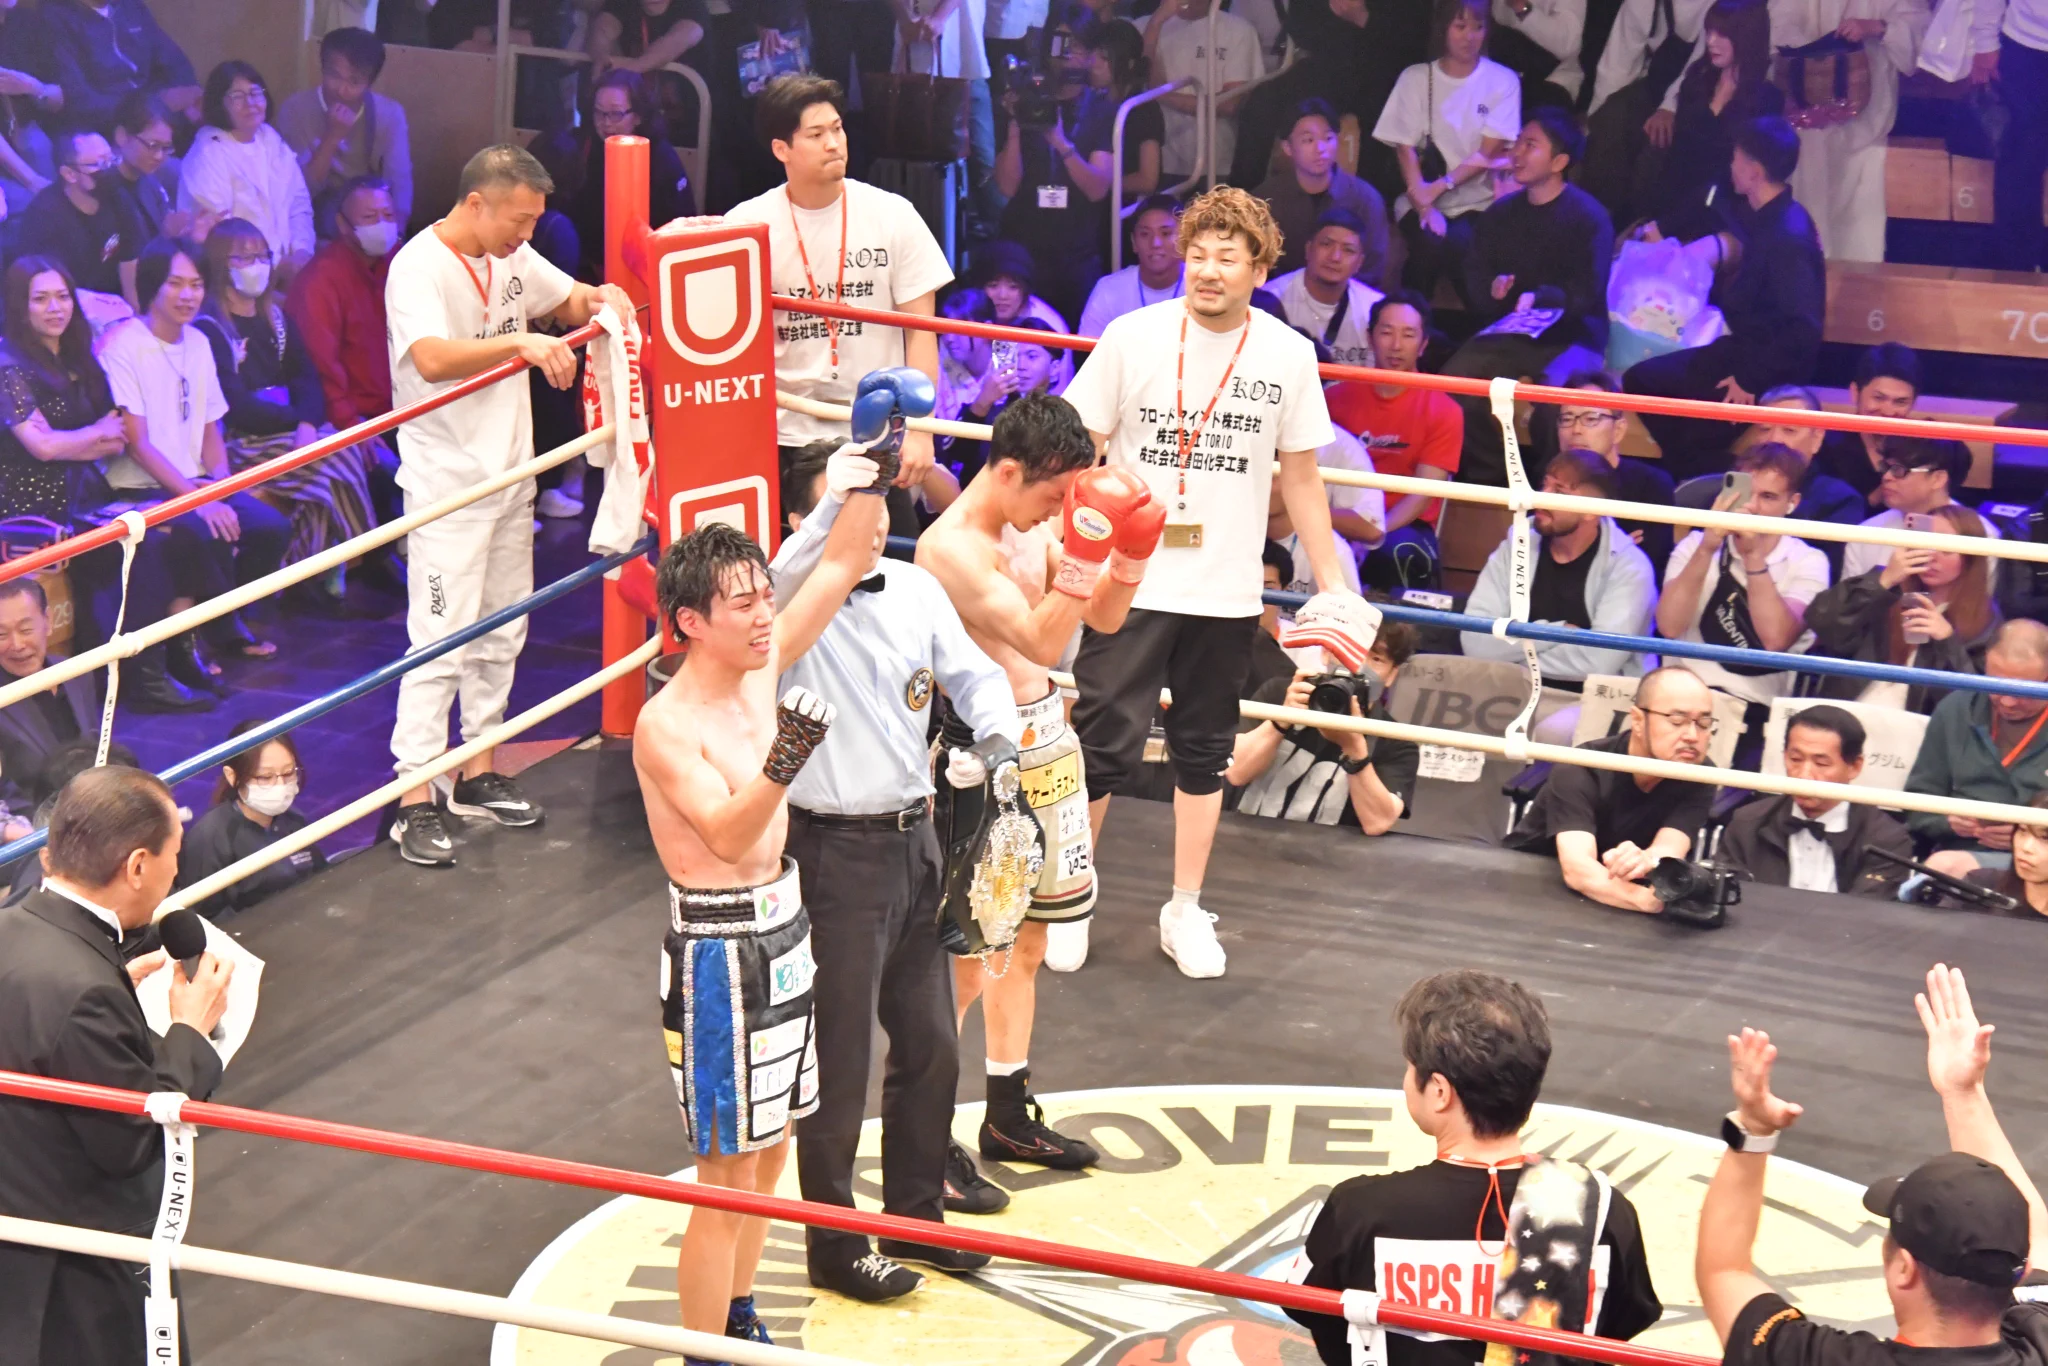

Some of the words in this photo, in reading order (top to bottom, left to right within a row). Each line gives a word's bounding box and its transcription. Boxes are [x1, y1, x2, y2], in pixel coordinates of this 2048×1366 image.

[1958, 186, 1974, 208] 6
[1867, 309, 1884, 331] 6
[664, 373, 765, 408] U-NEXT
[1231, 376, 1282, 405] KOD
[1205, 433, 1233, 449] TORIO
[1516, 549, 1525, 597] U-NEXT
[428, 574, 446, 618] RAZOR
[162, 1171, 187, 1243] U-NEXT
[1384, 1262, 1462, 1314] ISPS
